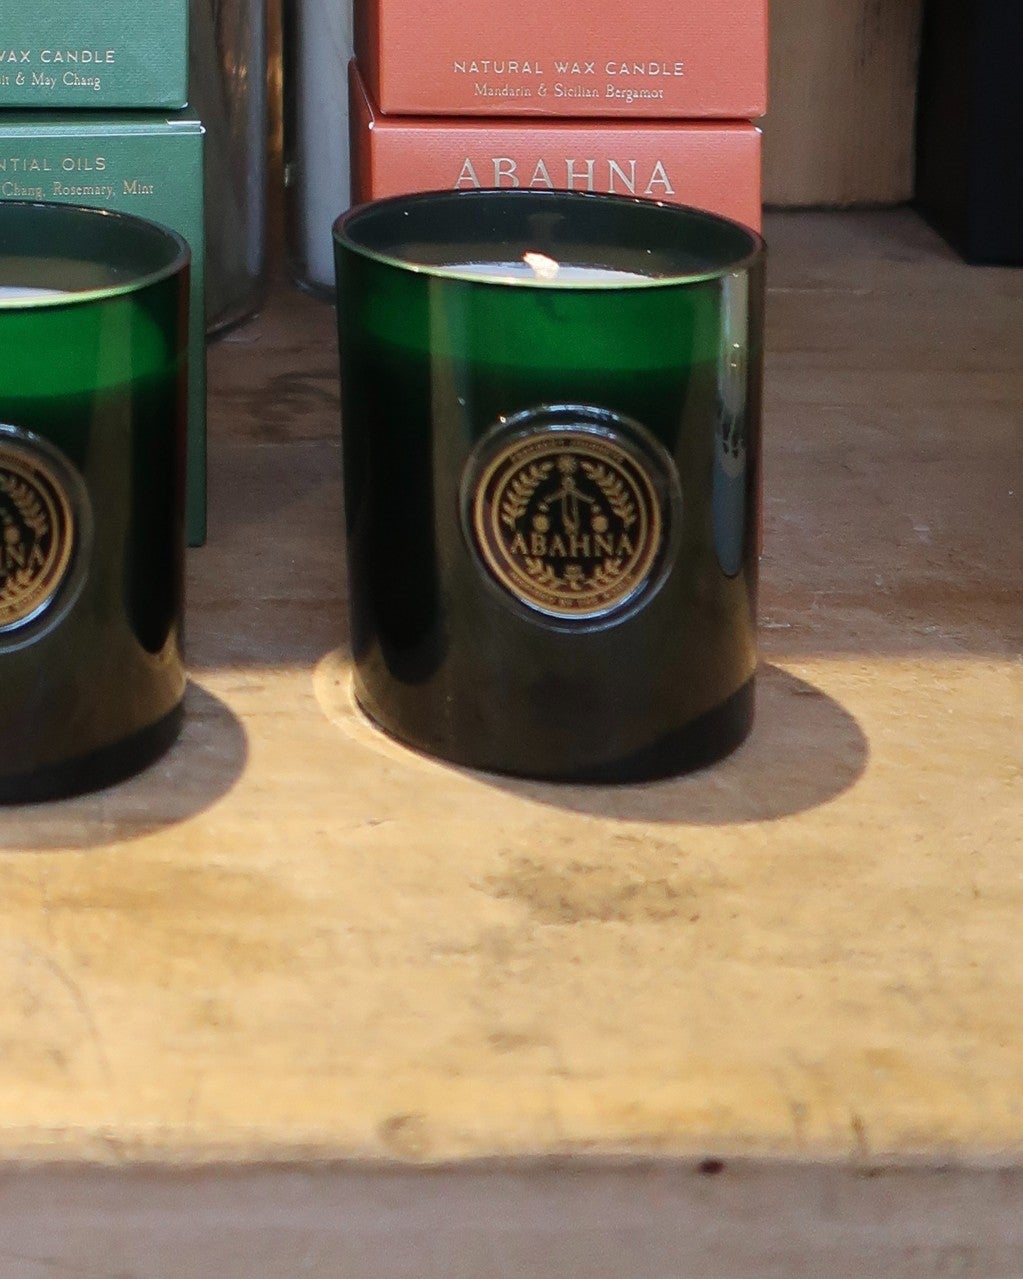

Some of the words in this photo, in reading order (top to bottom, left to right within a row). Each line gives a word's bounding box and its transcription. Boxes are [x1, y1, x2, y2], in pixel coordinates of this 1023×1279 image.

[40, 50, 116, 63] CANDLE
[454, 61, 543, 74] NATURAL
[554, 62, 595, 74] WAX
[606, 62, 684, 76] CANDLE
[15, 72, 25, 85] &
[31, 72, 57, 89] May
[62, 71, 101, 91] Chang
[474, 83, 531, 97] Mandarin
[537, 84, 547, 97] &
[554, 83, 599, 97] Sicilian
[606, 84, 664, 103] Bergamot
[62, 157, 107, 171] OILS
[453, 157, 675, 195] ABAHNA
[123, 180, 154, 195] Mint
[510, 532, 634, 557] ABAHNA
